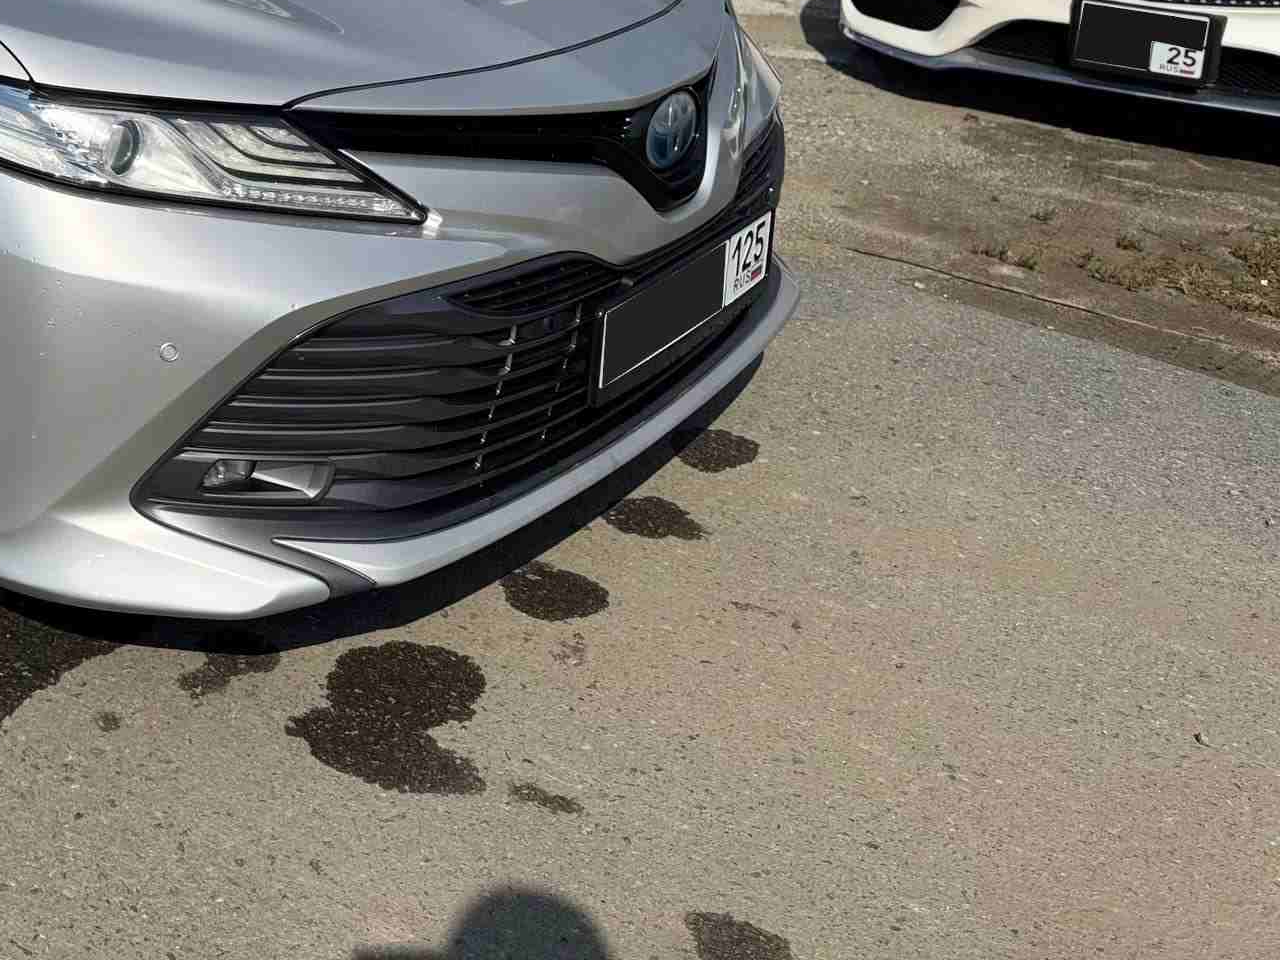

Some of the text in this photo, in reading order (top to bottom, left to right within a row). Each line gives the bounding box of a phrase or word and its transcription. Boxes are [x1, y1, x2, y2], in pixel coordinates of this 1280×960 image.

[1166, 46, 1198, 68] 25
[732, 220, 766, 277] 125
[734, 270, 753, 290] RUS
